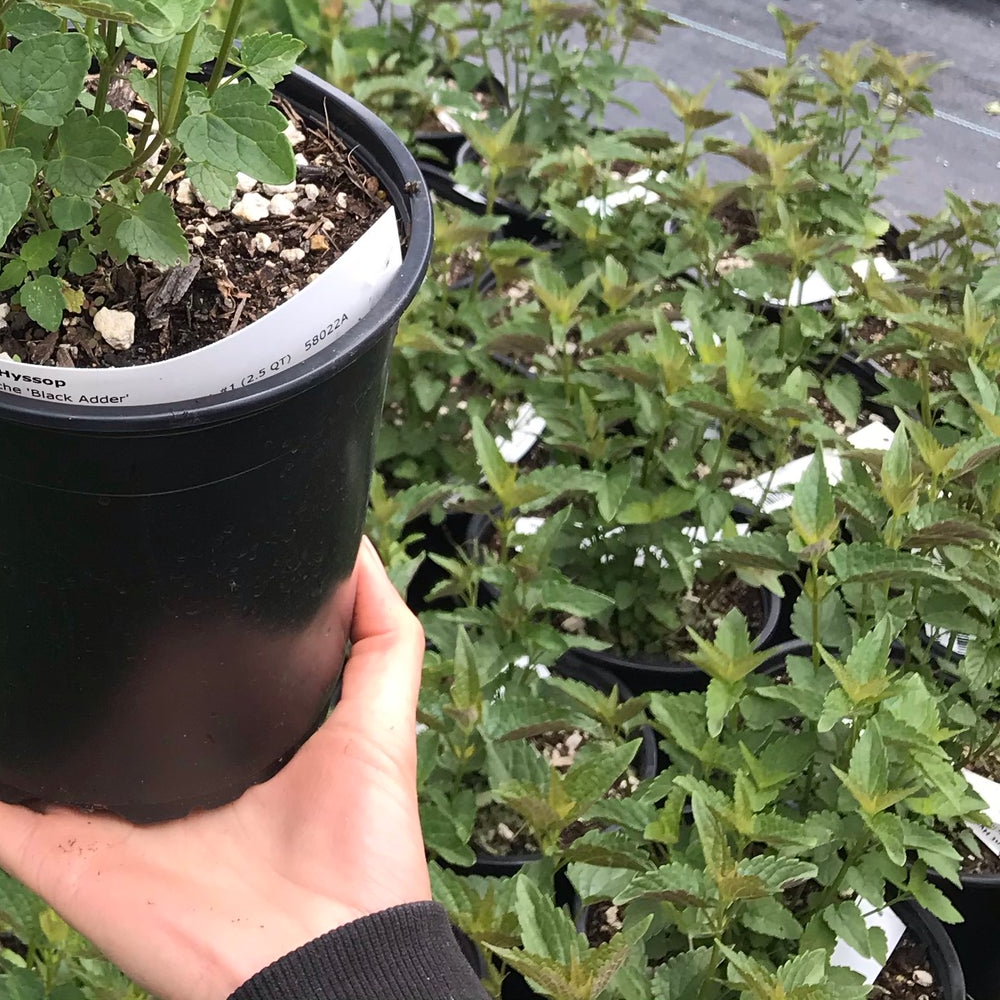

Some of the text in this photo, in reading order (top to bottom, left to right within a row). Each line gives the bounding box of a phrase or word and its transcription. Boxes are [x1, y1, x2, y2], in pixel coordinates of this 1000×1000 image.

[241, 368, 266, 387] (2.5
[270, 354, 292, 371] QT)
[304, 313, 349, 351] 58022A
[26, 387, 73, 402] 'Black
[78, 393, 130, 404] Adder'
